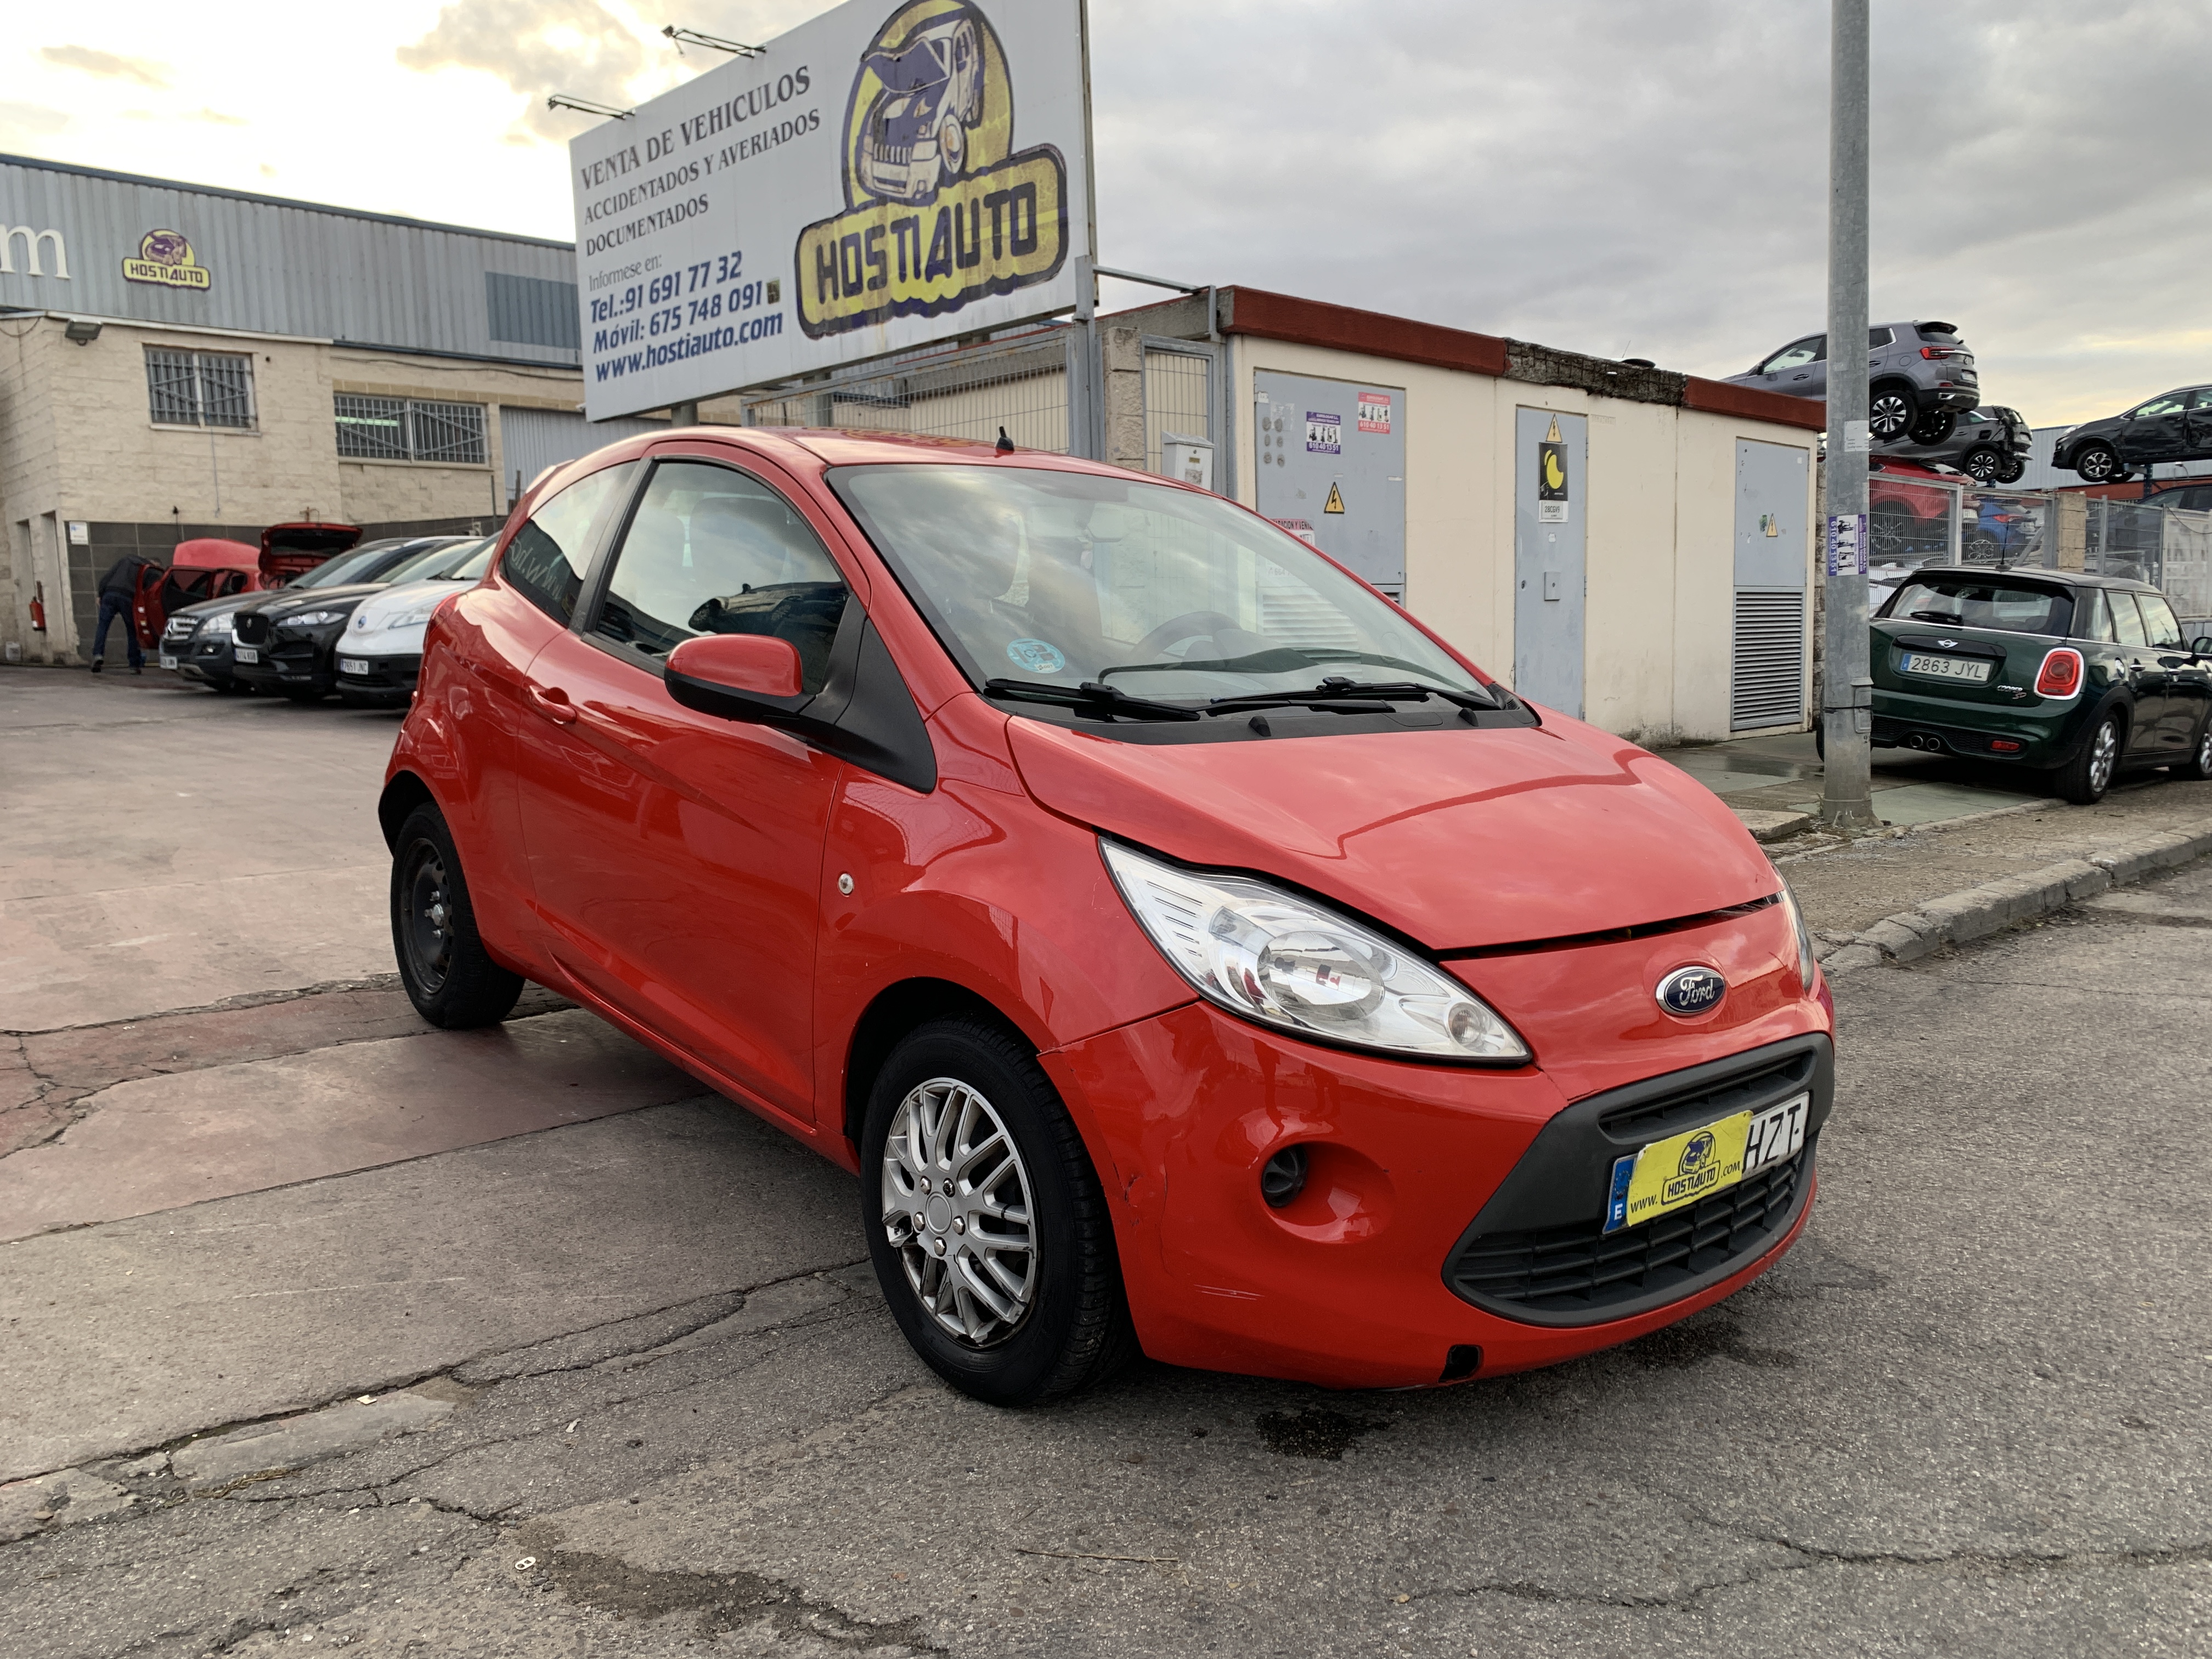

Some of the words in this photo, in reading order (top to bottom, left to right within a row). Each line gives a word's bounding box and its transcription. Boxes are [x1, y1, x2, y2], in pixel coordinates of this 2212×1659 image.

[582, 145, 641, 190] VENTA
[646, 129, 675, 163] DE
[680, 65, 811, 146] VEHICULOS
[585, 161, 699, 225] ACCIDENTADOS
[705, 153, 715, 175] Y
[718, 108, 821, 171] AVERIADOS
[586, 193, 709, 257] DOCUMENTADOS
[816, 181, 1037, 305] HOSTIAUTO
[131, 263, 203, 284] HOSTIAUTO
[645, 254, 662, 272] en:
[649, 271, 681, 304] 691
[688, 261, 711, 293] 77
[716, 250, 742, 284] 32
[593, 318, 645, 354] Móvil:
[650, 305, 682, 337] 675
[688, 294, 721, 326] 748
[729, 280, 763, 313] 091
[596, 312, 783, 382] www.hostiauto.com
[1831, 538, 1837, 549] 40
[1831, 551, 1837, 561] 13
[1831, 562, 1837, 572] 51
[1911, 657, 1950, 674] 2863
[1955, 661, 1982, 678] JYL
[1679, 975, 1715, 1006] Ford
[1742, 1103, 1801, 1174] HZT
[1614, 1203, 1623, 1221] E
[1630, 1194, 1658, 1214] WWW.
[1667, 1166, 1716, 1198] HOSTIAUTO
[1720, 1160, 1741, 1178] .COM
